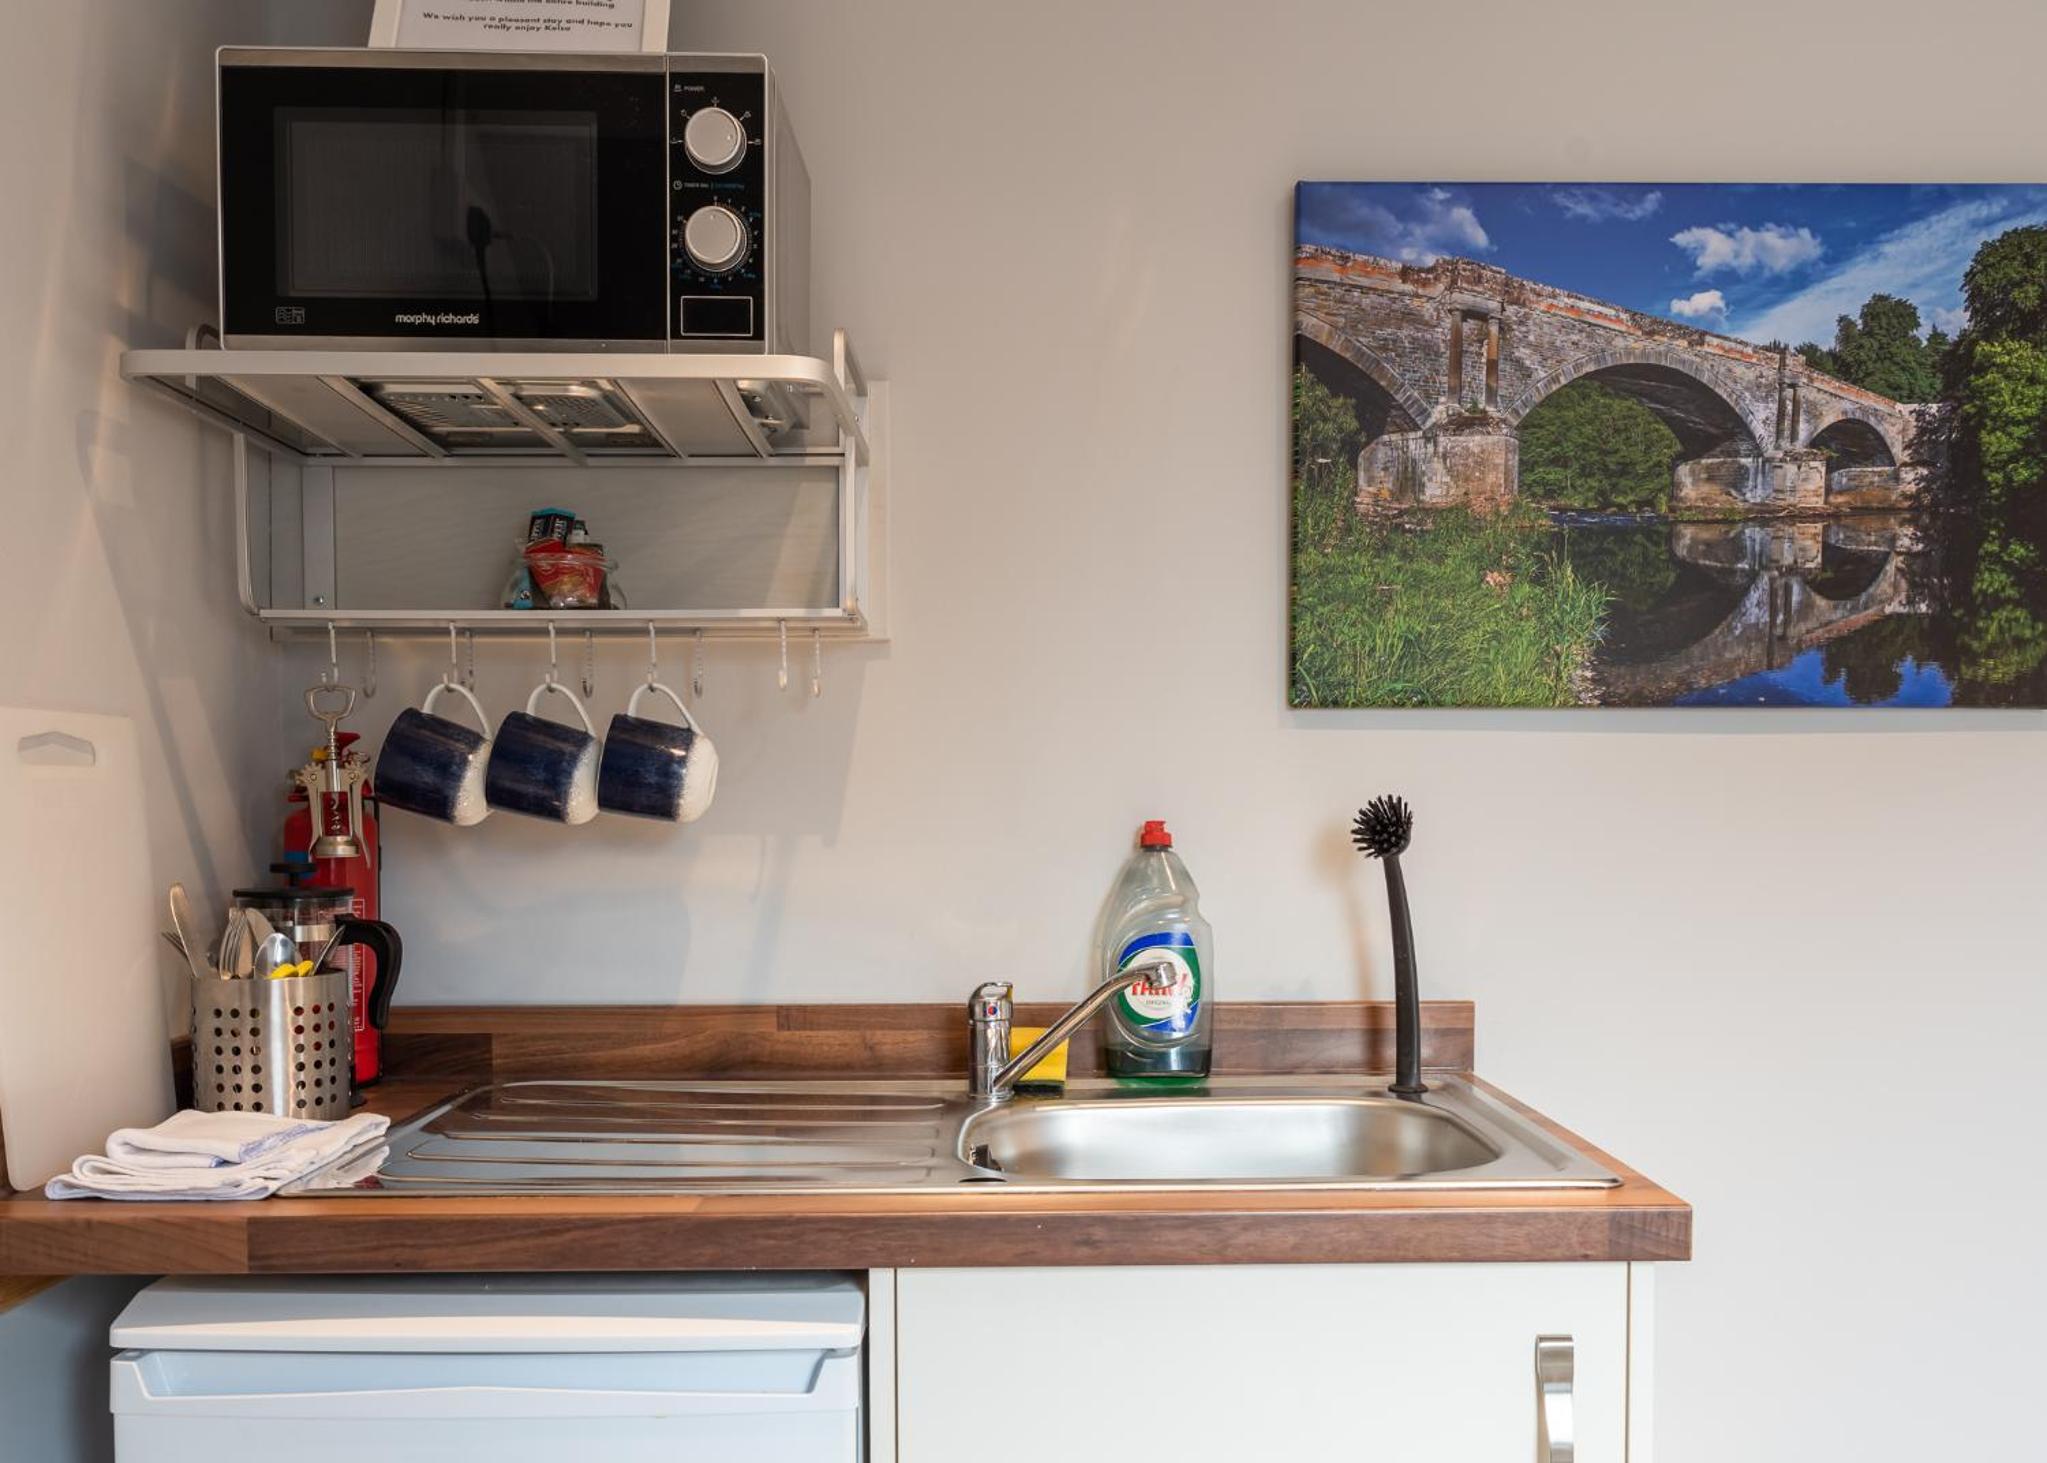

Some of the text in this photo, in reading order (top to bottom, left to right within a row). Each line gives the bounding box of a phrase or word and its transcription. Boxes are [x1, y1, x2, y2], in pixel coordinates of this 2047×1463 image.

[575, 0, 614, 9] building
[587, 18, 611, 27] hope
[395, 313, 478, 325] morphy richards
